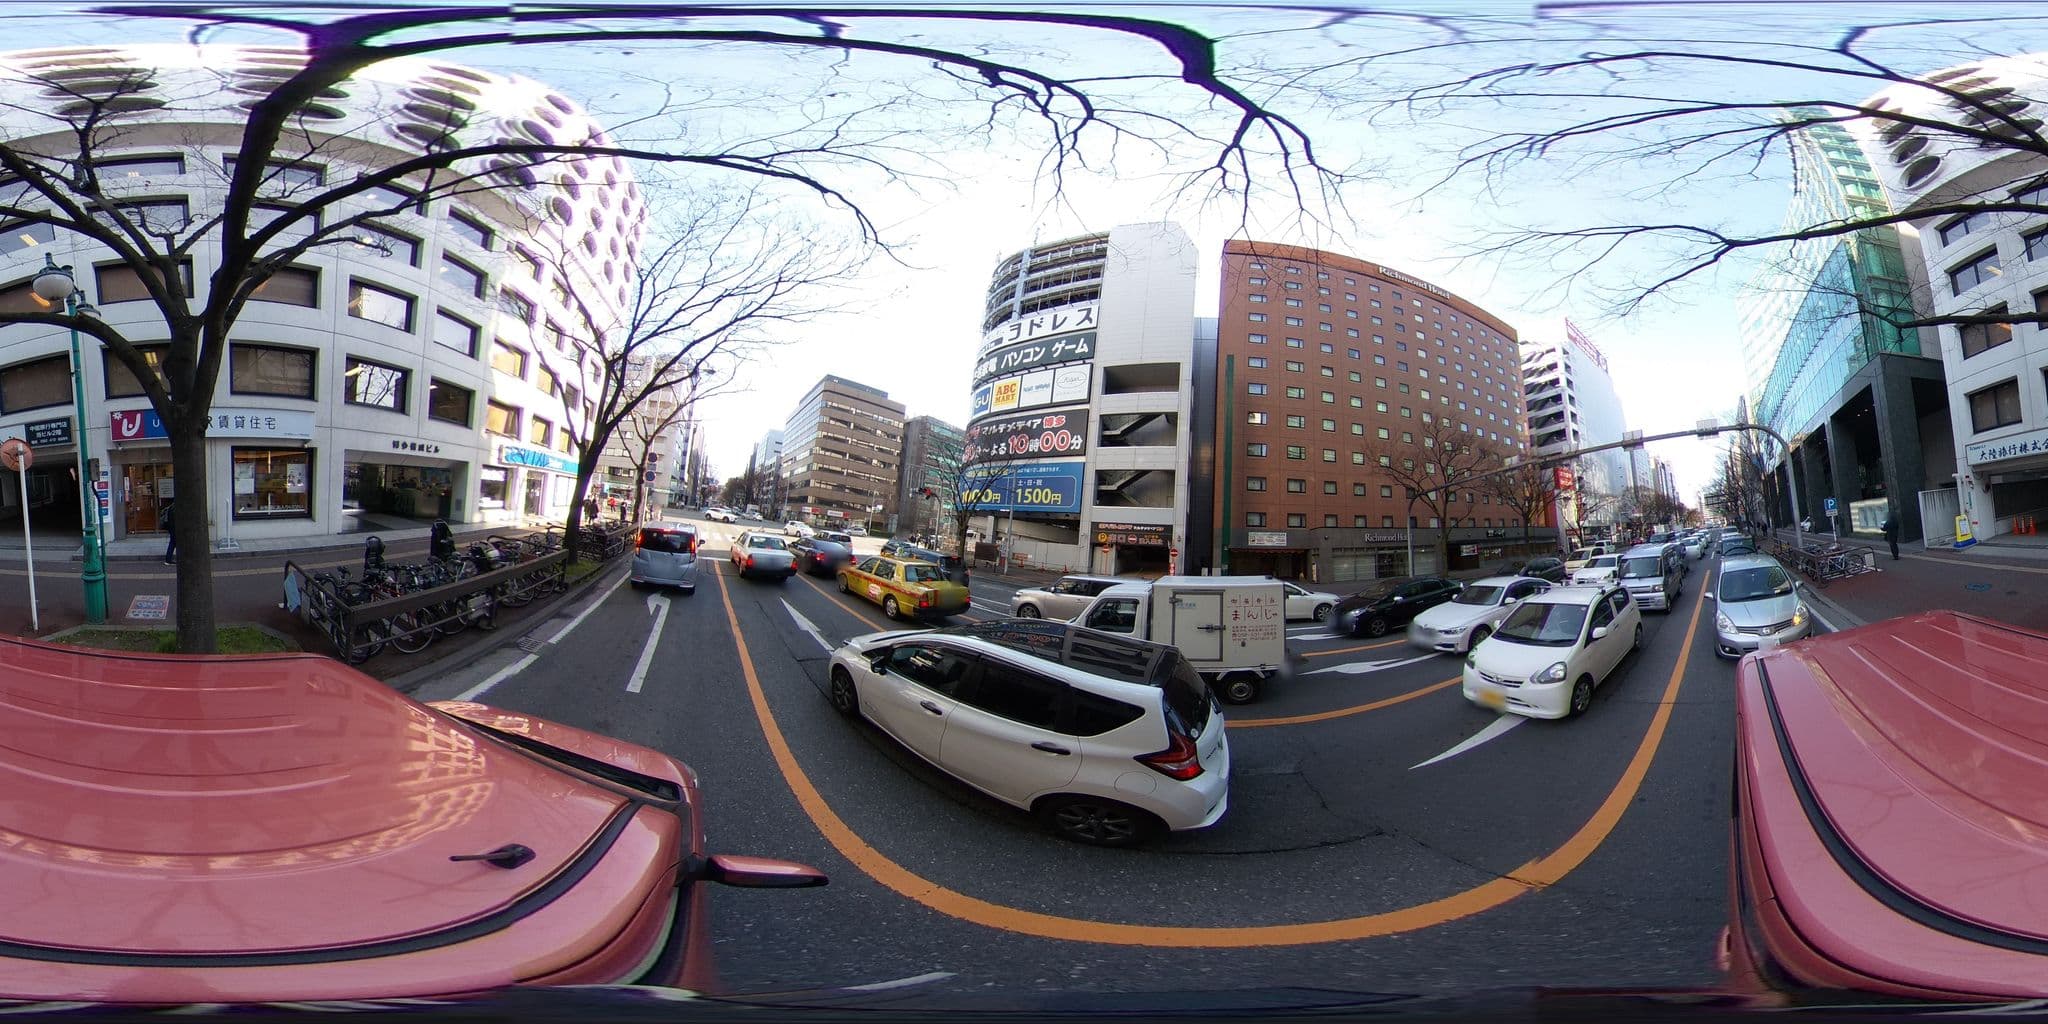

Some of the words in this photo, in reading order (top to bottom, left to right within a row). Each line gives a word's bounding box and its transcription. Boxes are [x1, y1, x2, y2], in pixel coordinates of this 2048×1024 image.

[1379, 266, 1427, 289] Richmond
[1428, 284, 1450, 299] Hotel
[1000, 346, 1046, 369] パソコン
[1053, 338, 1089, 357] ゲーム
[995, 383, 1017, 396] ABC
[974, 394, 989, 408] GU
[994, 393, 1016, 404] MART
[1016, 488, 1061, 505] 1500円
[1364, 531, 1396, 542] Richmond
